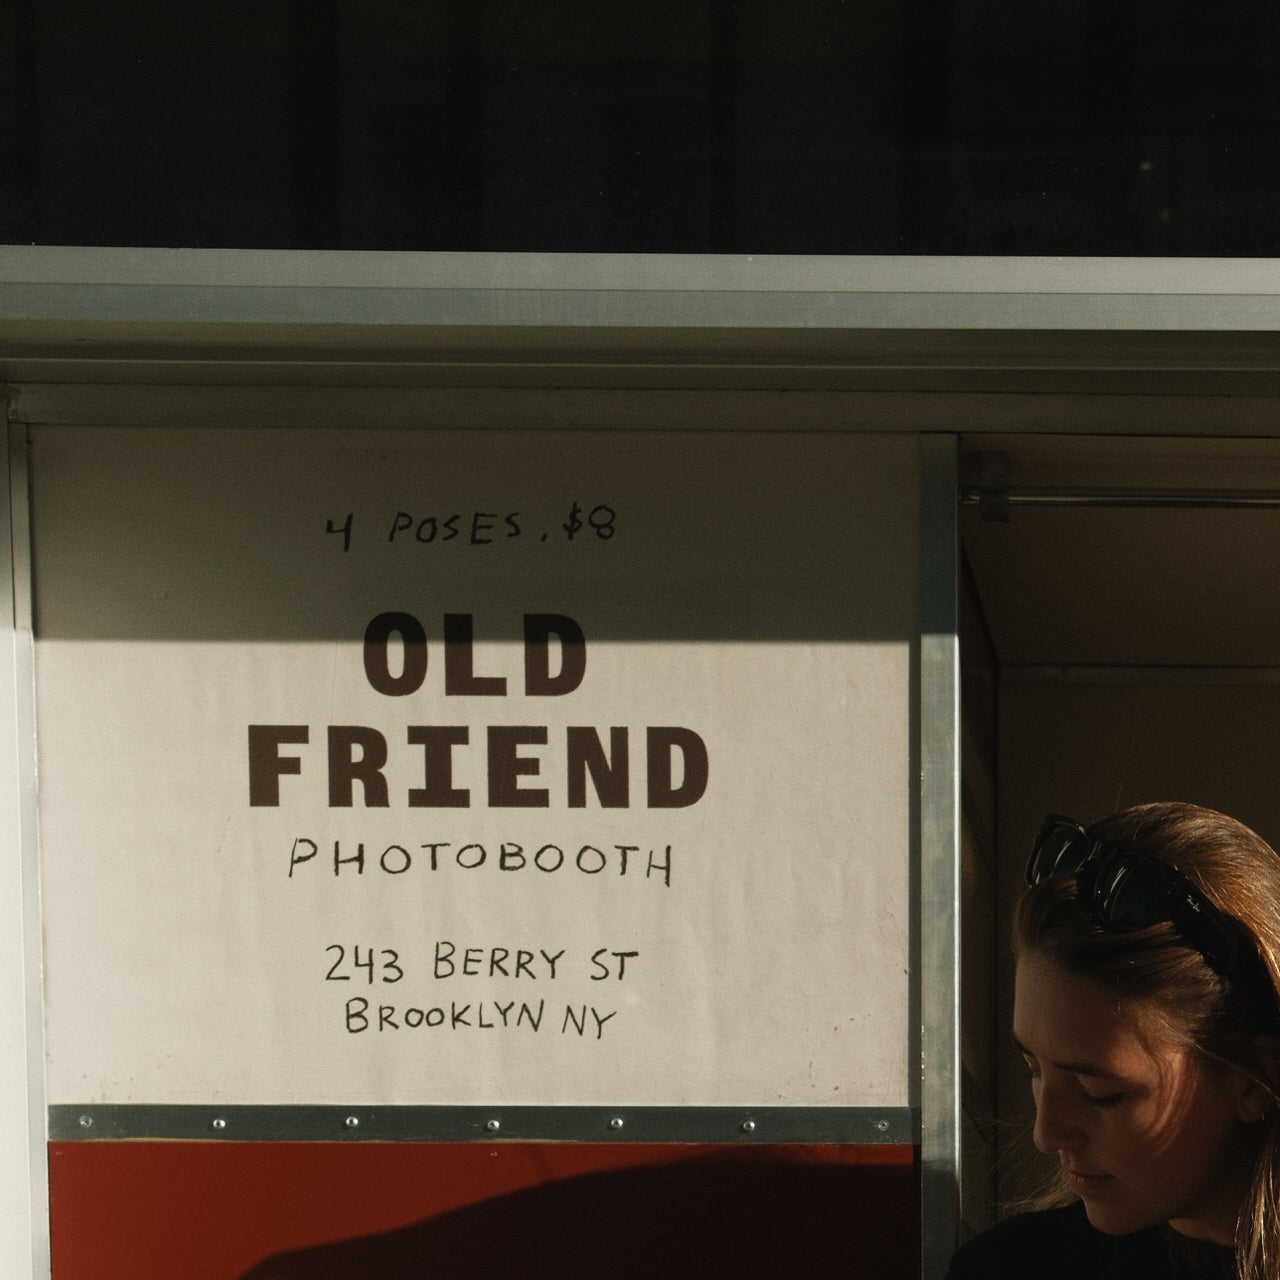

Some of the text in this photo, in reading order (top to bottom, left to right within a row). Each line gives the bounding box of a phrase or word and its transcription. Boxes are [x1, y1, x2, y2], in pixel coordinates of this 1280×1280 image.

[326, 513, 353, 552] 4
[562, 501, 616, 541] $8
[363, 611, 587, 697] OLD
[248, 724, 709, 809] FRIEND
[289, 837, 672, 888] PHOTOBOOTH
[325, 941, 639, 985] 243 BERRY ST
[345, 996, 618, 1040] BROOKLYN NY
